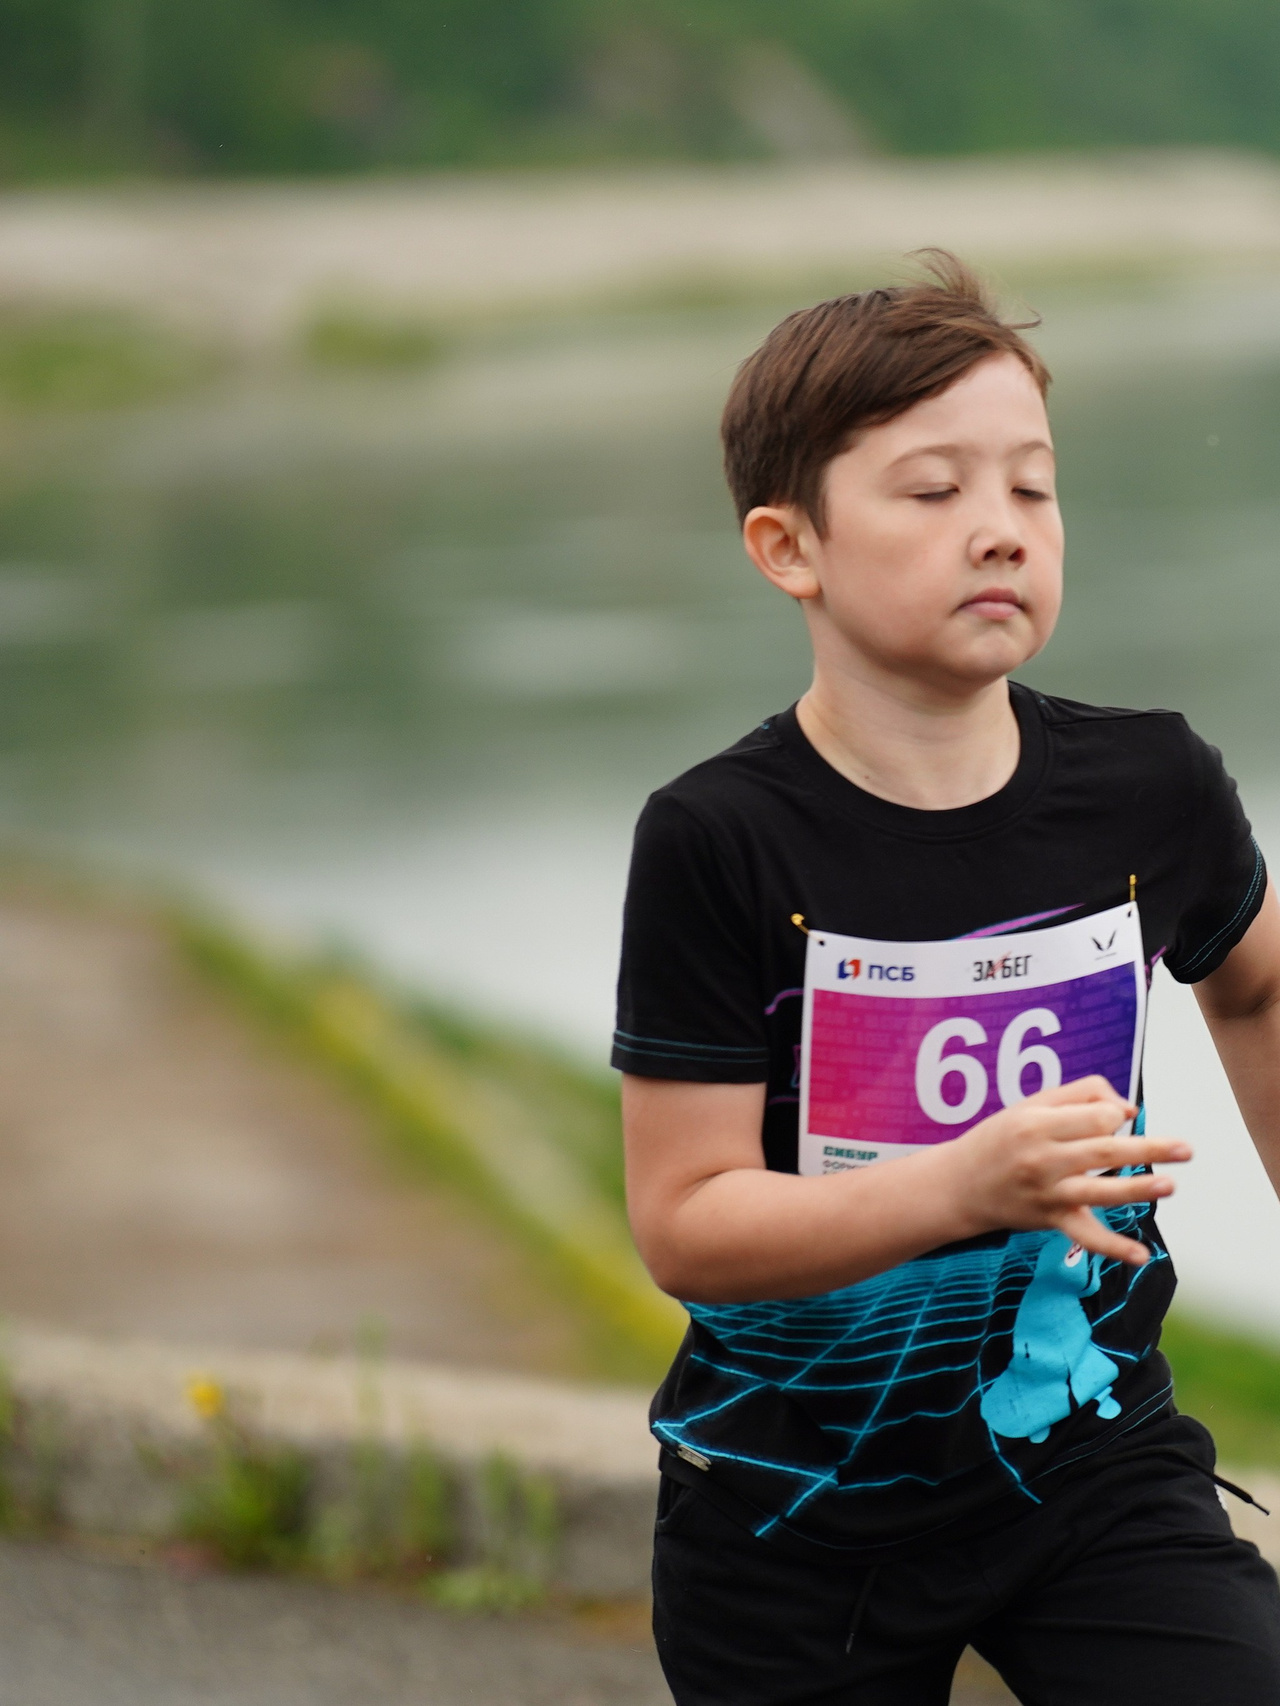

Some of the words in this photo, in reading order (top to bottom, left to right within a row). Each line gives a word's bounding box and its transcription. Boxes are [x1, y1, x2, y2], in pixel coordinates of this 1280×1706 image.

[868, 964, 915, 982] ПСБ
[915, 1007, 1062, 1125] 66
[823, 1146, 878, 1161] СИБУР
